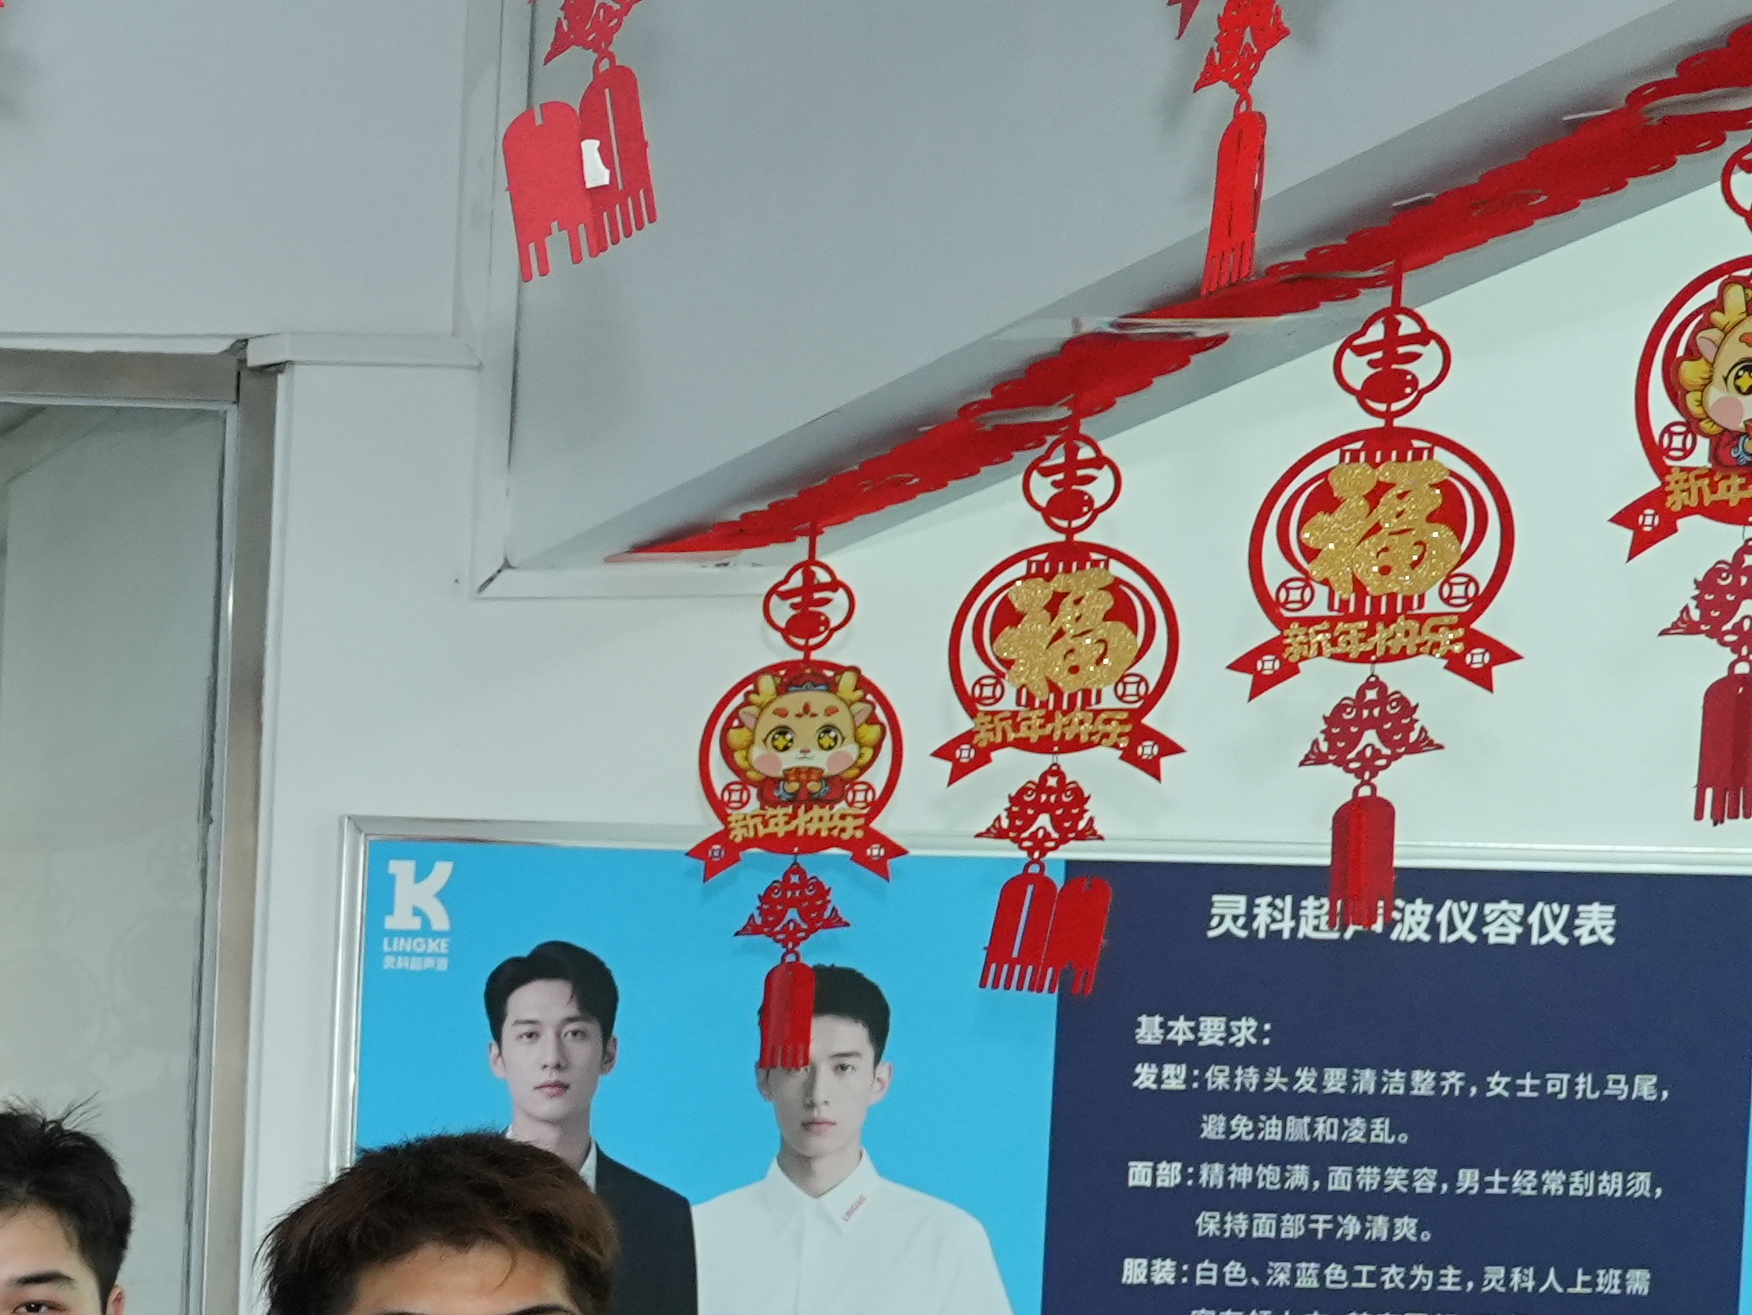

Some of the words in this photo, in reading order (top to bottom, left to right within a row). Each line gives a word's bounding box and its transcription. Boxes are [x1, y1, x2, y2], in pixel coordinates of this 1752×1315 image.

[1664, 466, 1752, 512] 新年
[1299, 459, 1465, 597] 福
[992, 569, 1143, 703] 福
[1282, 614, 1465, 660] 新年快乐
[973, 708, 1133, 750] 新年快乐
[728, 806, 865, 844] 新年快乐
[383, 936, 451, 953] LINGKE
[1135, 1014, 1271, 1047] 基本要求：
[1200, 1114, 1408, 1144] 避免油腻和凌乱。
[1196, 1211, 1431, 1241] 保持面部干净清爽。
